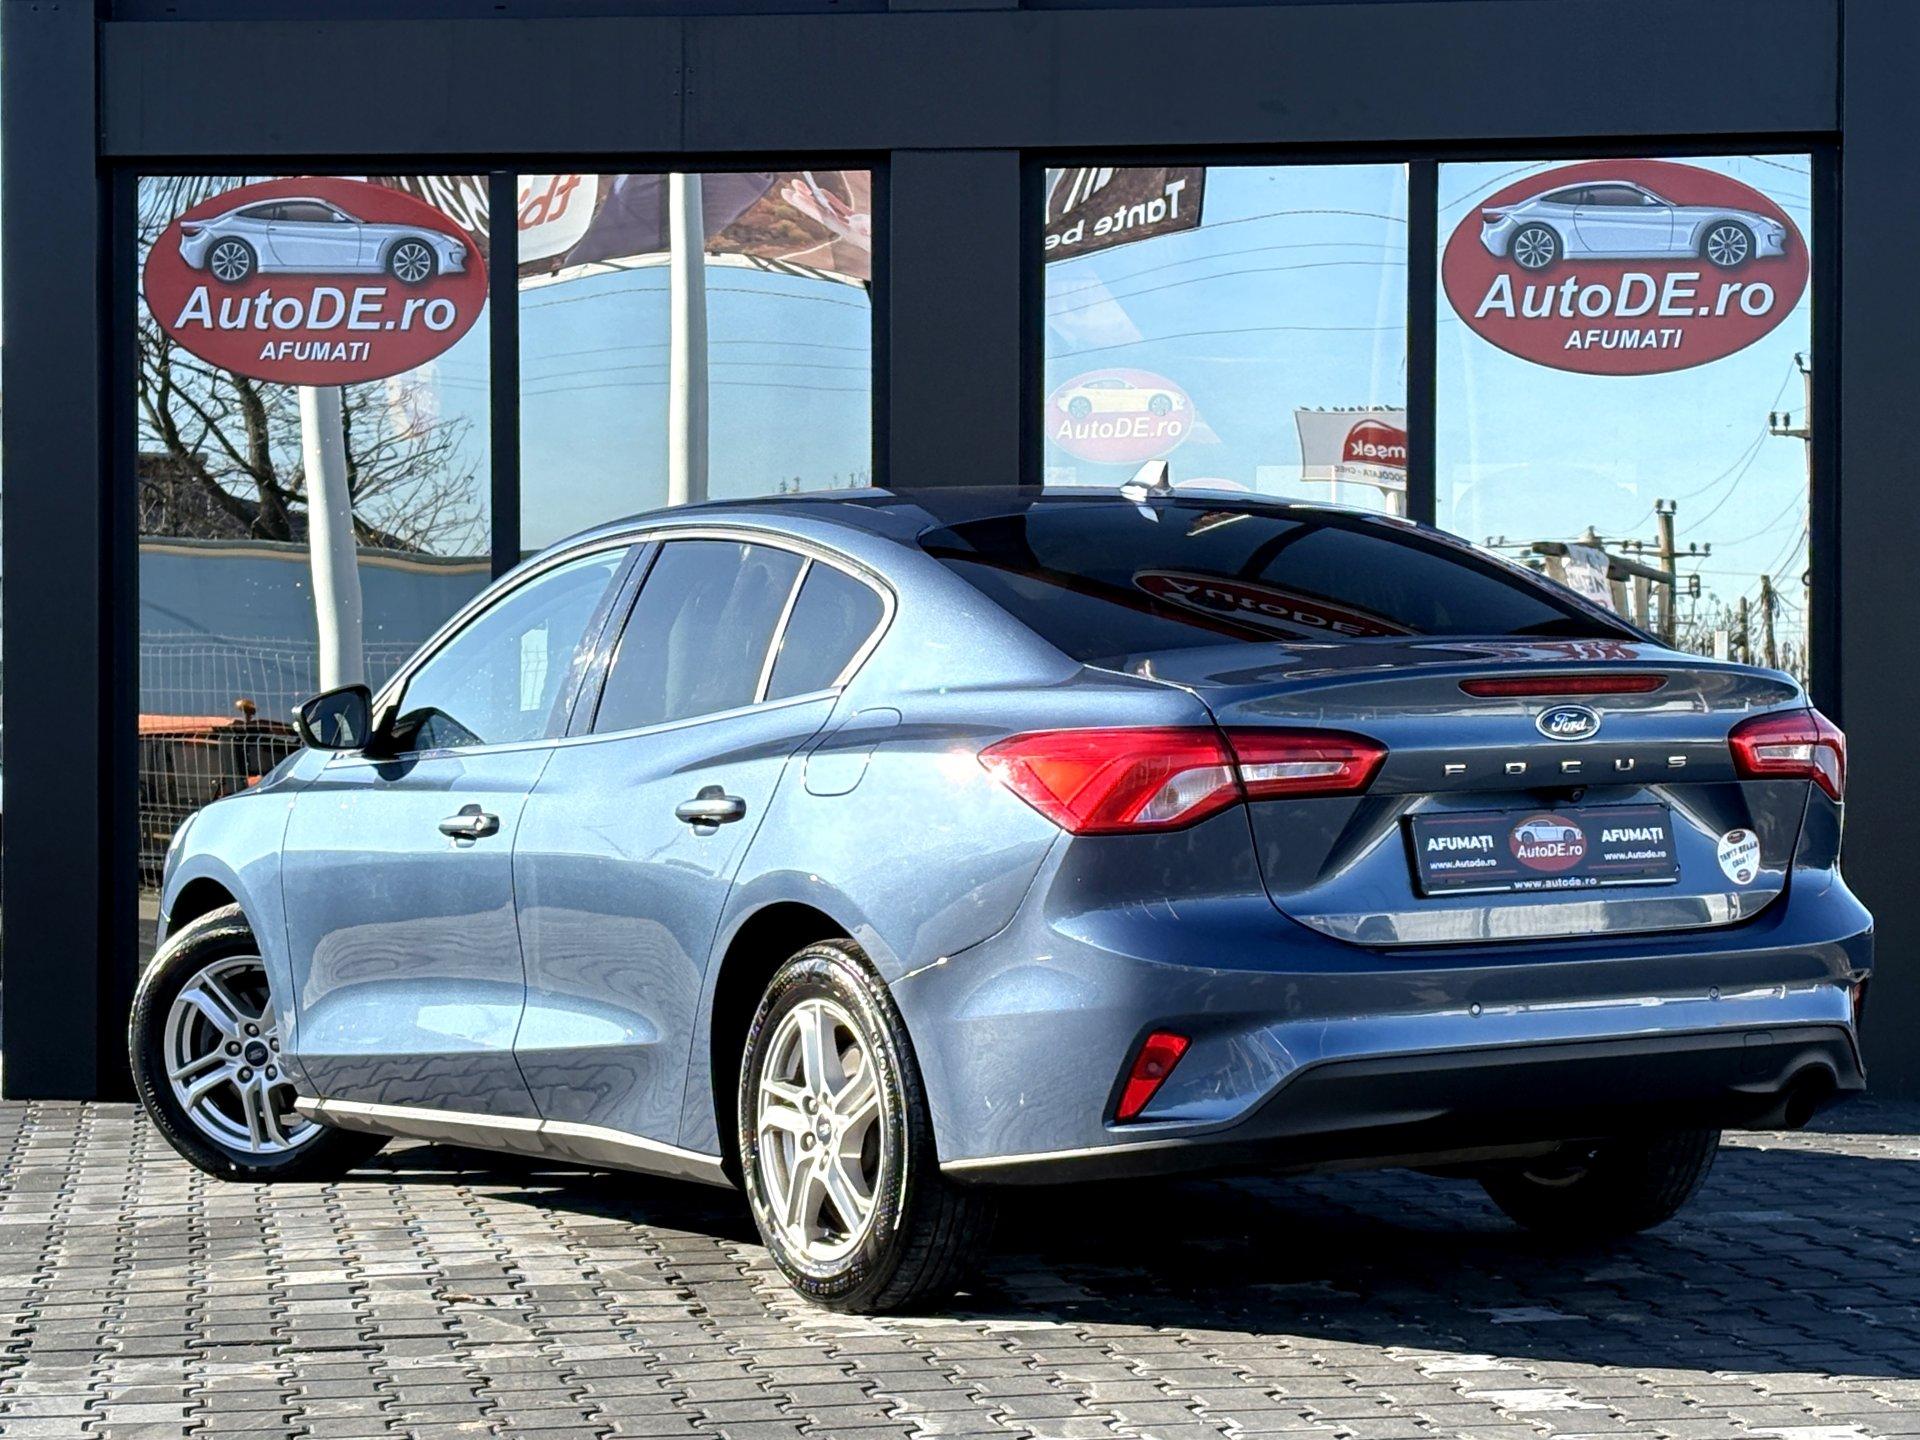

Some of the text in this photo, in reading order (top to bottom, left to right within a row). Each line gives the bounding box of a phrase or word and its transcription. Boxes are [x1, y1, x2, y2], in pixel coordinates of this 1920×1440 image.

[1475, 272, 1776, 319] AutoDE.ro
[175, 286, 458, 332] AutoDE.ro
[1564, 329, 1684, 350] AFUMATI
[259, 341, 371, 363] AFUMATI
[1056, 417, 1183, 440] AutoDE.ro
[1551, 713, 1588, 733] Ford
[1444, 755, 1688, 777] FOCUS
[1517, 842, 1583, 859] AutoDE.ro
[1514, 876, 1597, 889] www.autode.ro
